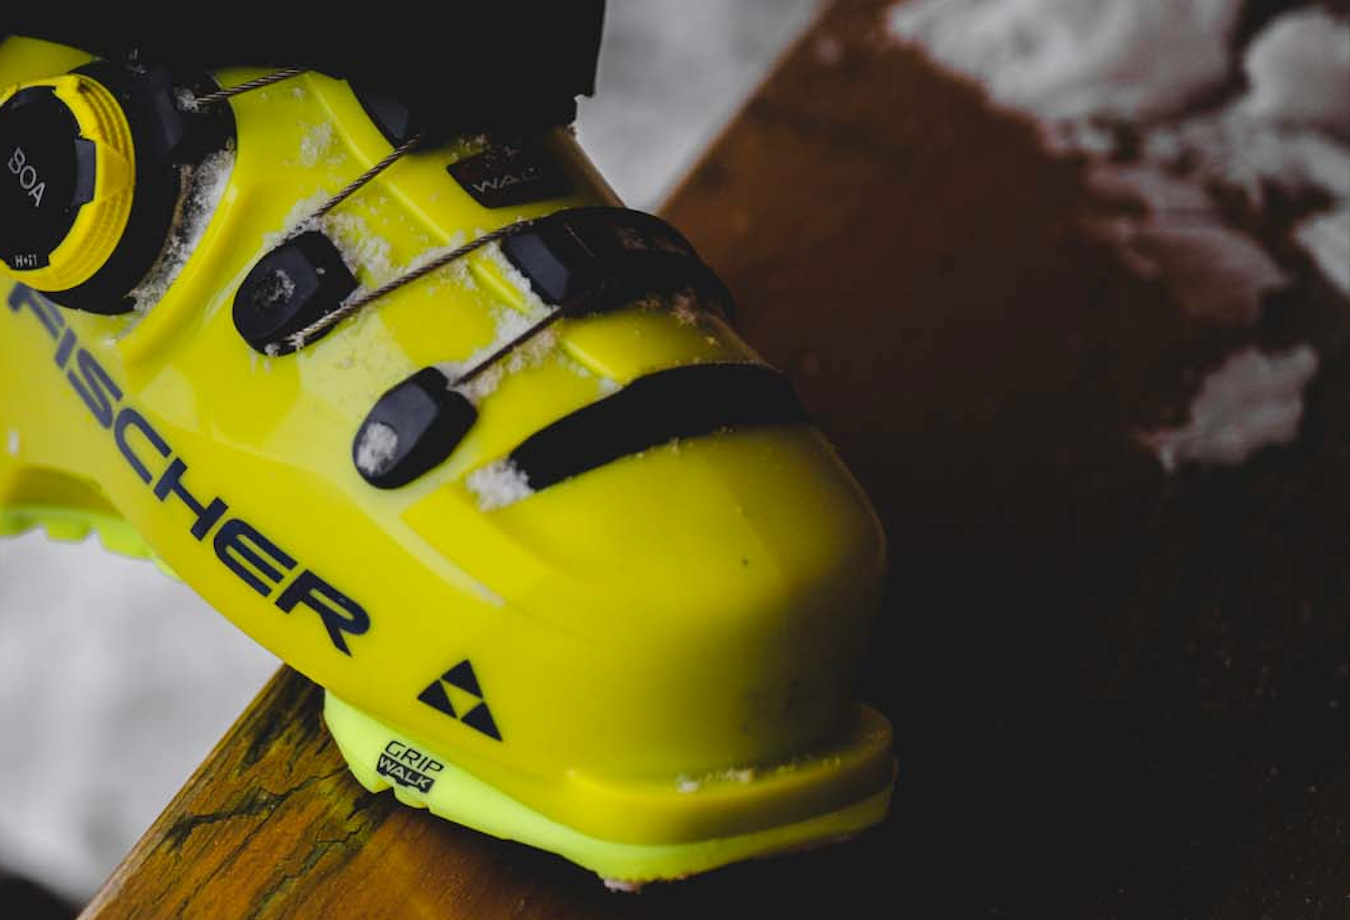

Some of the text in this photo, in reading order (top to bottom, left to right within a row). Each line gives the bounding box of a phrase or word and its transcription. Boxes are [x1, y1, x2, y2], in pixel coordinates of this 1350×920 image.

[7, 146, 46, 208] BOA
[7, 281, 370, 658] FISCHER
[377, 755, 431, 789] WALK
[385, 740, 445, 773] GRIP
